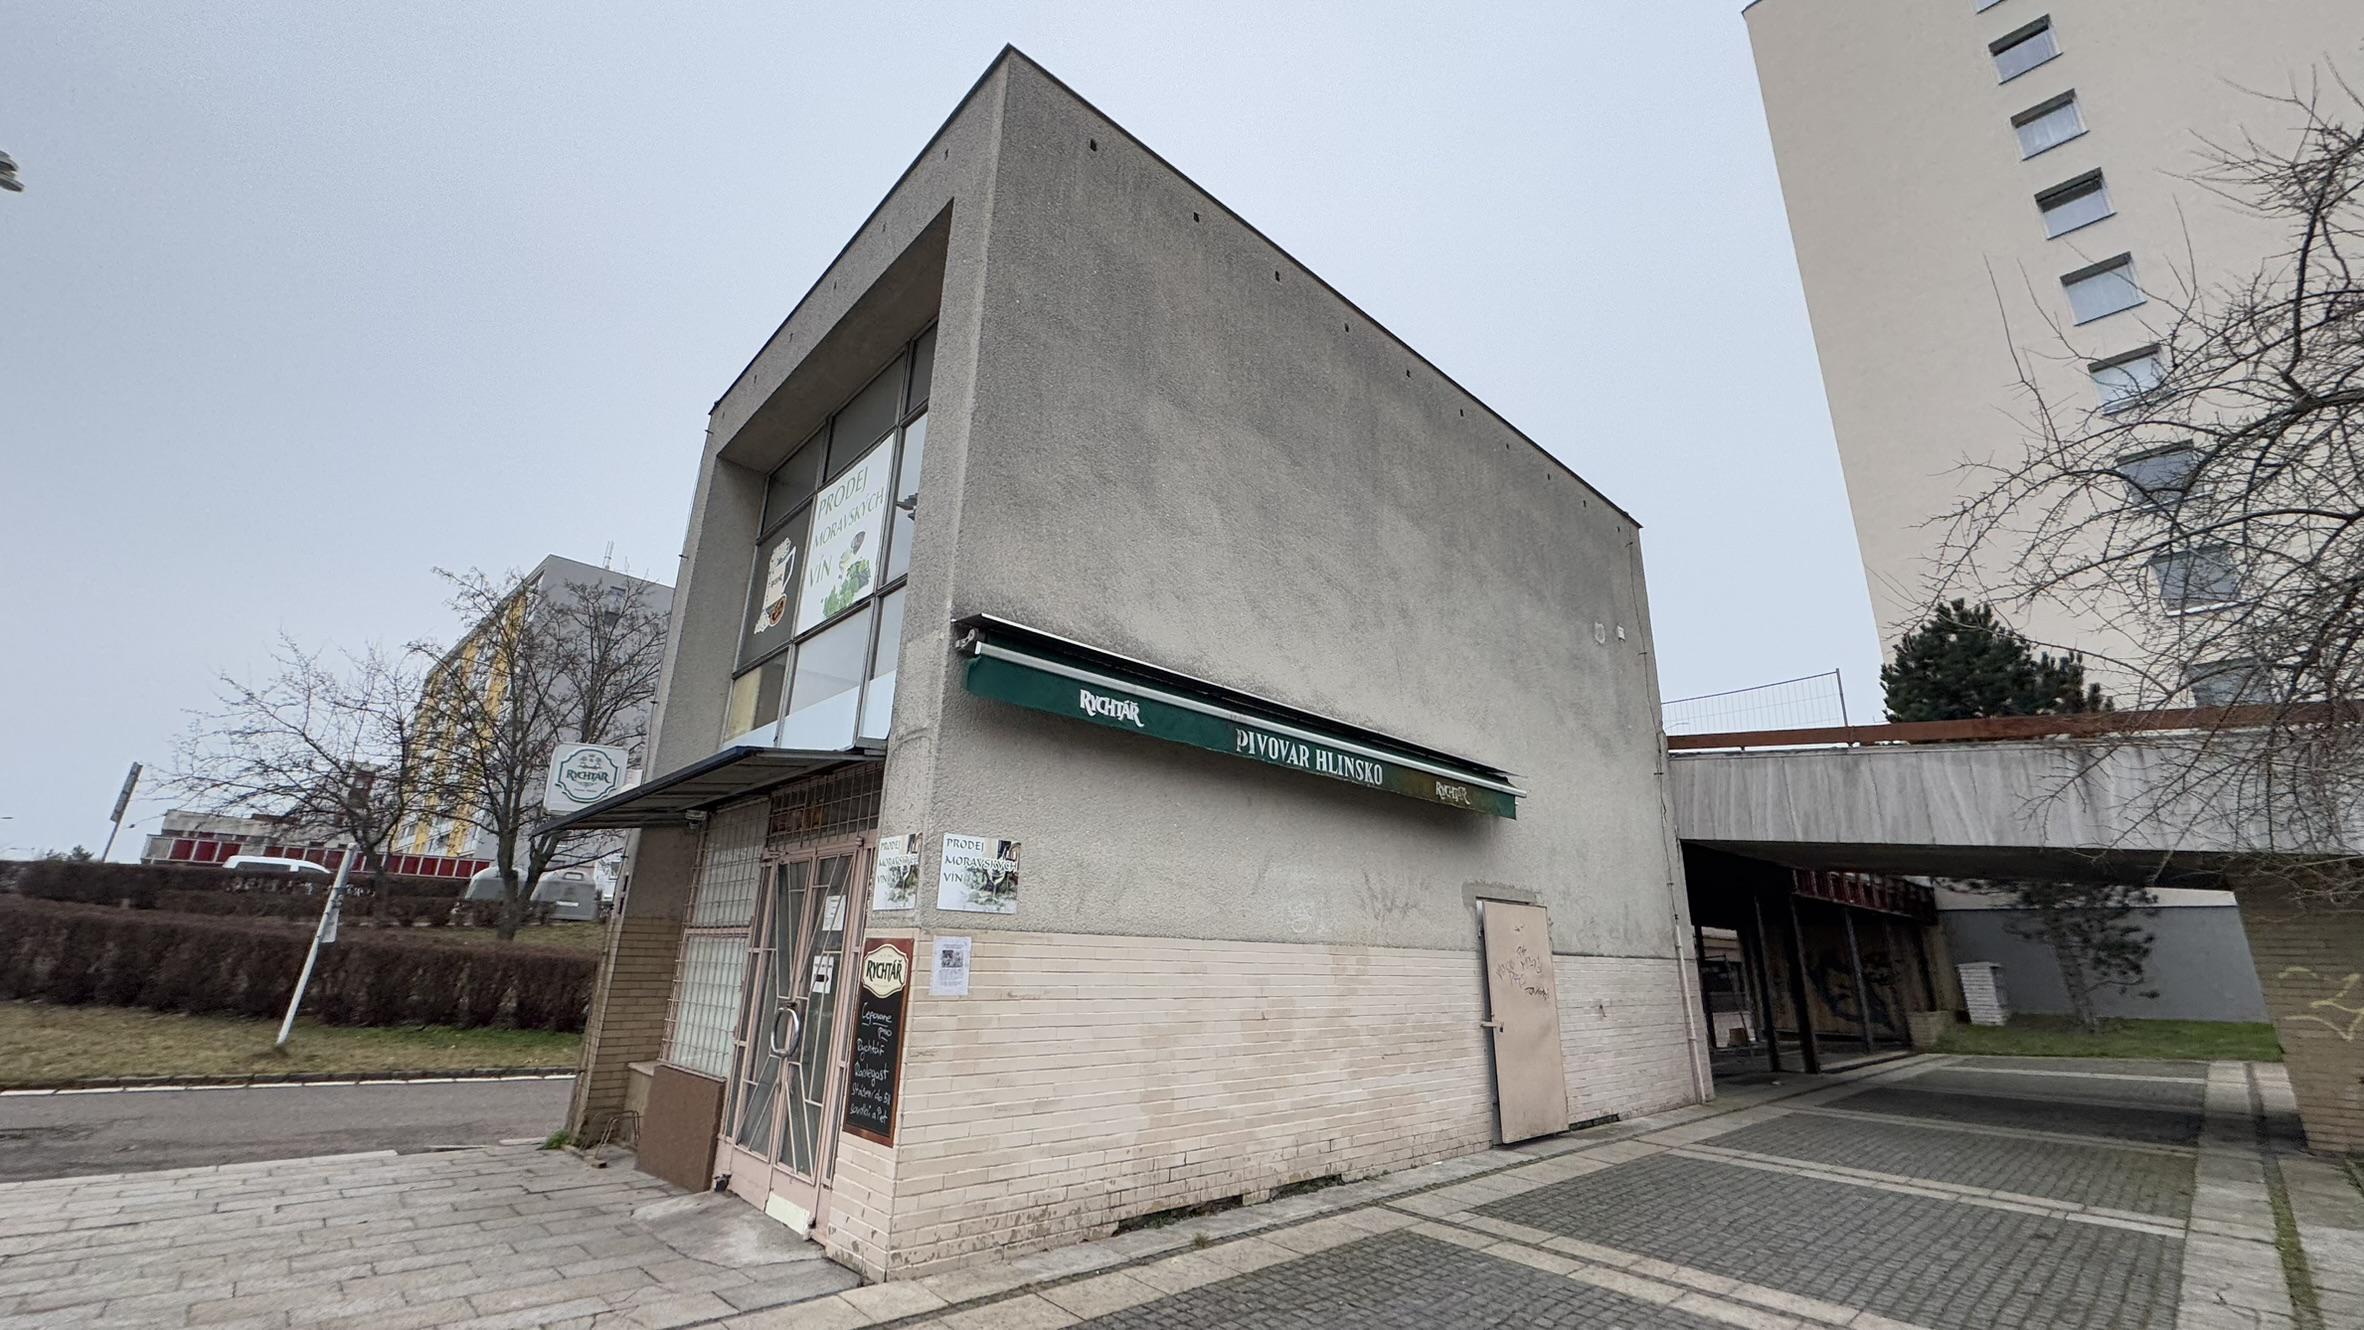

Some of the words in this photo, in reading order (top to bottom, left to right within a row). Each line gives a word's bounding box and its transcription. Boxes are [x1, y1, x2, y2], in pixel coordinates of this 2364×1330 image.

[818, 466, 868, 521] PRODEJ
[1080, 689, 1144, 727] RYCHTÁŘ
[1235, 728, 1310, 768] PIVOVAR
[1315, 749, 1383, 785] HLINSKO
[946, 838, 984, 852] PRODEJ
[866, 959, 904, 985] RYCHTÁŘ
[854, 1061, 889, 1087] Radegast
